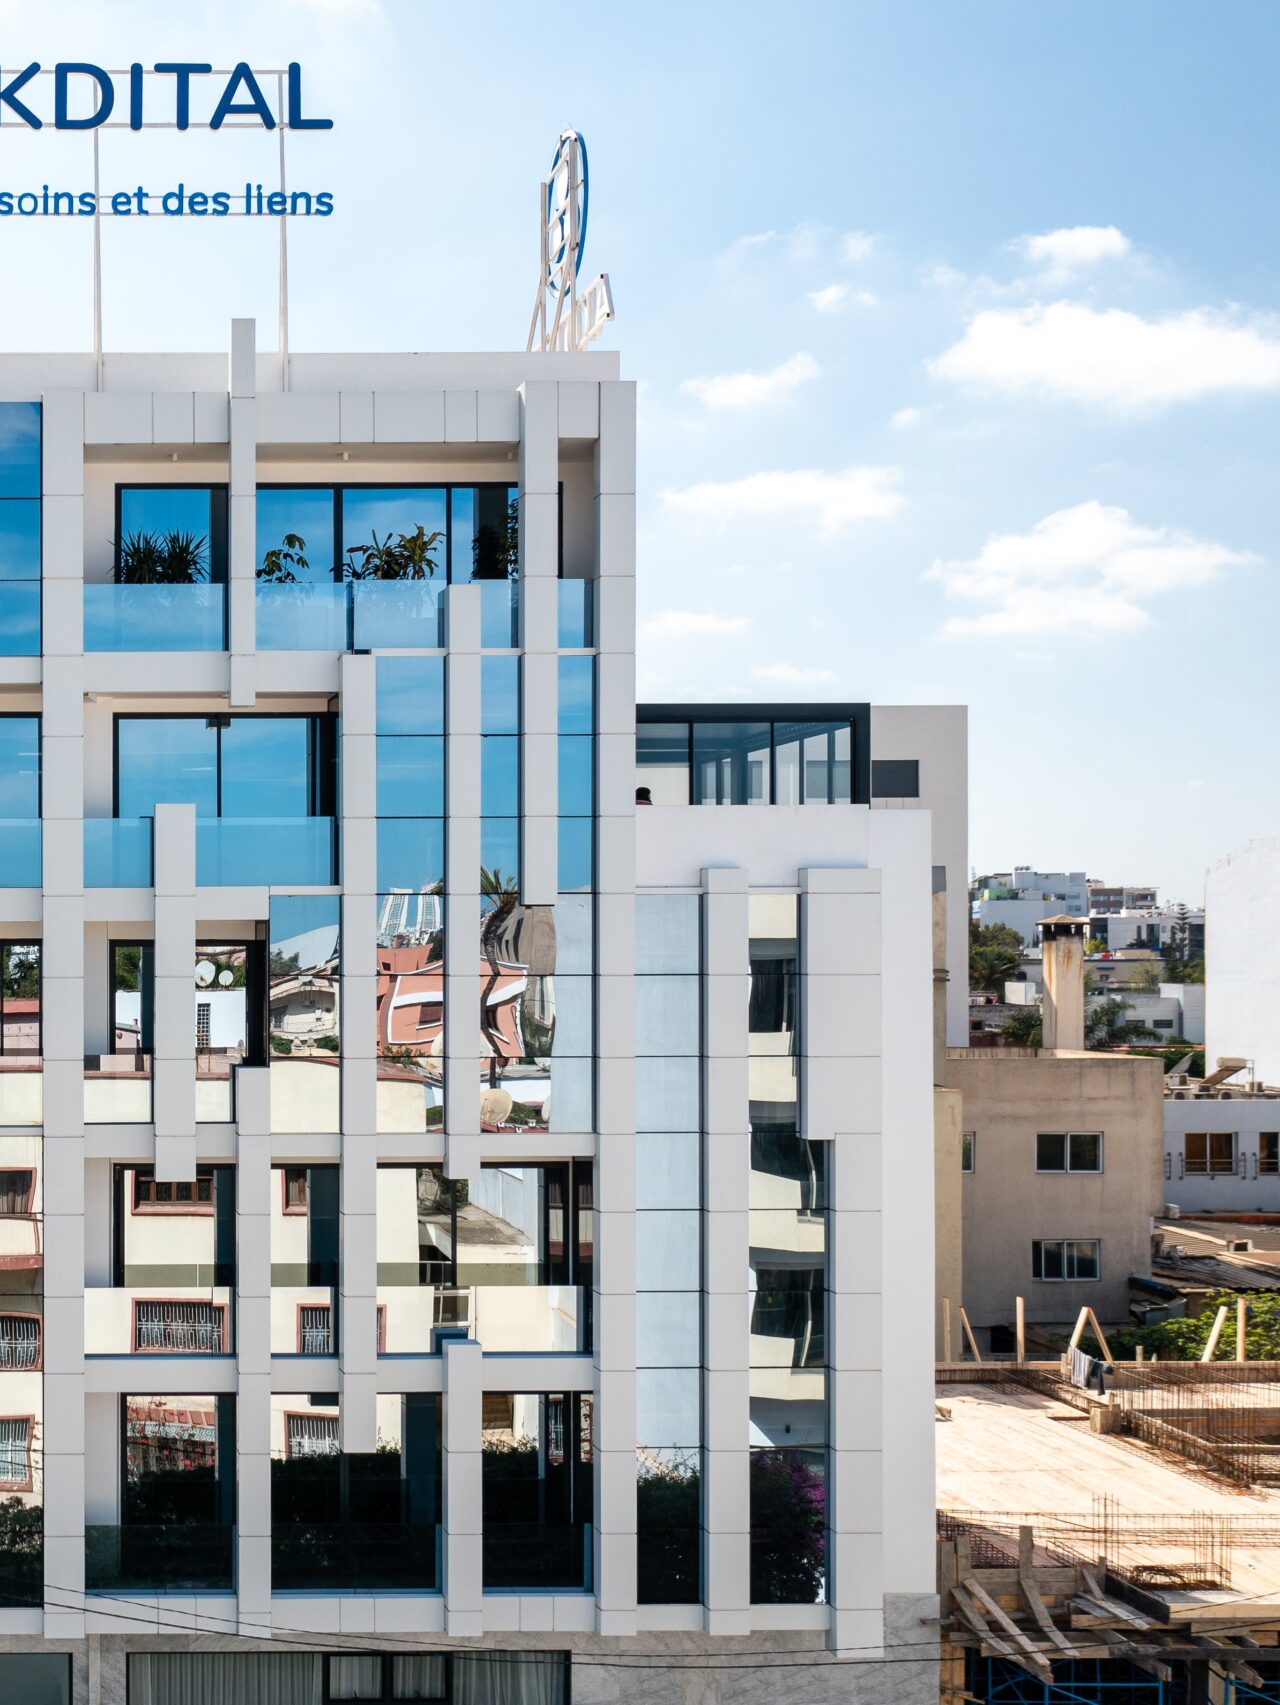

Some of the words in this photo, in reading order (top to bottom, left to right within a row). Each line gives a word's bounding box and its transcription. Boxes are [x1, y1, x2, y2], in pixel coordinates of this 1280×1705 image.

[111, 186, 150, 215] et
[161, 183, 231, 215] des
[244, 183, 334, 215] liens
